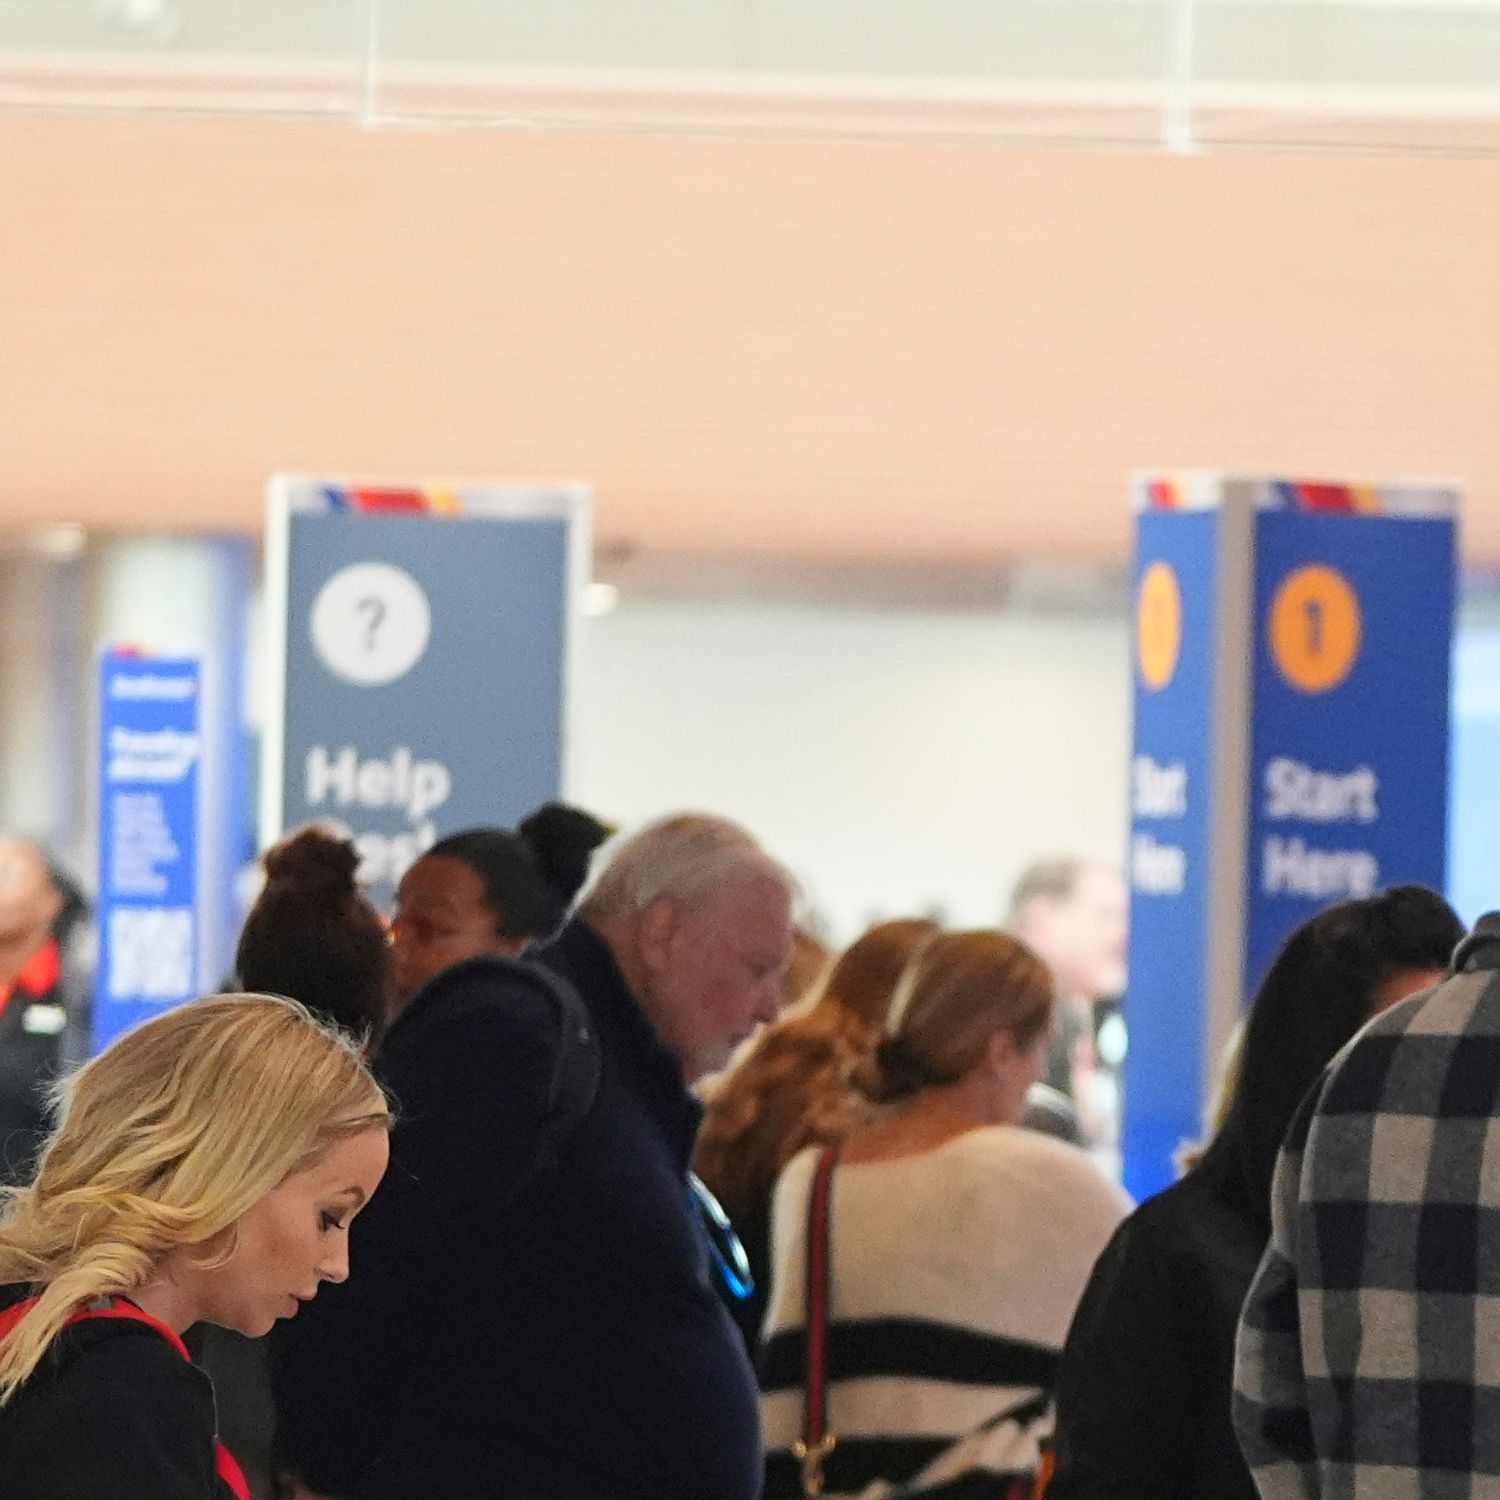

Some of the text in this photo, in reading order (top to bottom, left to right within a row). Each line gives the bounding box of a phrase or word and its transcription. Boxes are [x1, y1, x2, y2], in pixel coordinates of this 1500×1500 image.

[304, 745, 453, 824] Help
[1263, 756, 1378, 824] Start
[1262, 836, 1379, 900] Here
